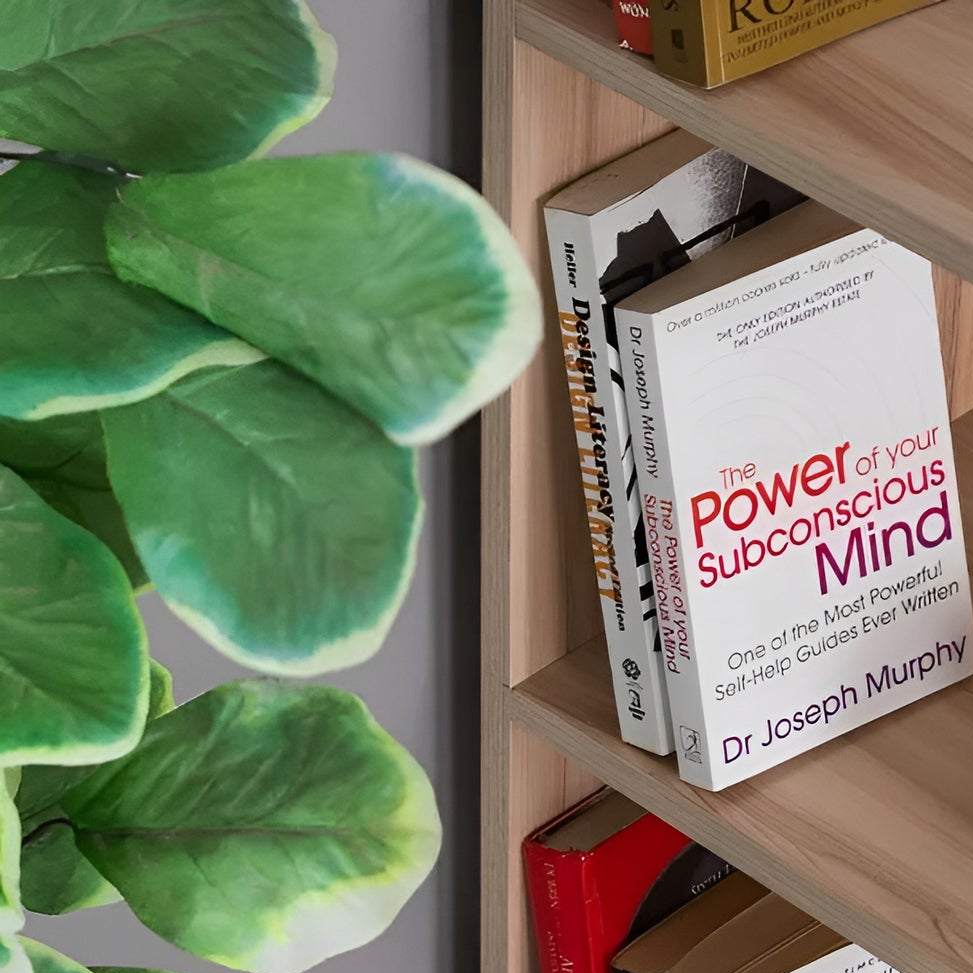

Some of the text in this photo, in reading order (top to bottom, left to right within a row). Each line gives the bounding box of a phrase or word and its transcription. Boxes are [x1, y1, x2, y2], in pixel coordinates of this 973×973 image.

[563, 241, 578, 288] Heller
[571, 297, 598, 393] Design
[587, 401, 616, 523] Literacy
[629, 326, 660, 479] Dr Joseph Murphy
[690, 425, 940, 549] The Power of your
[697, 459, 946, 589] Subconscious
[814, 490, 953, 595] Mind
[643, 493, 682, 675] Subconscious Mind
[660, 498, 692, 661] The Power of your
[714, 579, 961, 702] Self-Help Guides Ever Written
[727, 560, 944, 671] One of the Most Powerful
[721, 733, 753, 765] Dr
[761, 684, 860, 748] Joseph
[864, 634, 968, 699] Murphy
